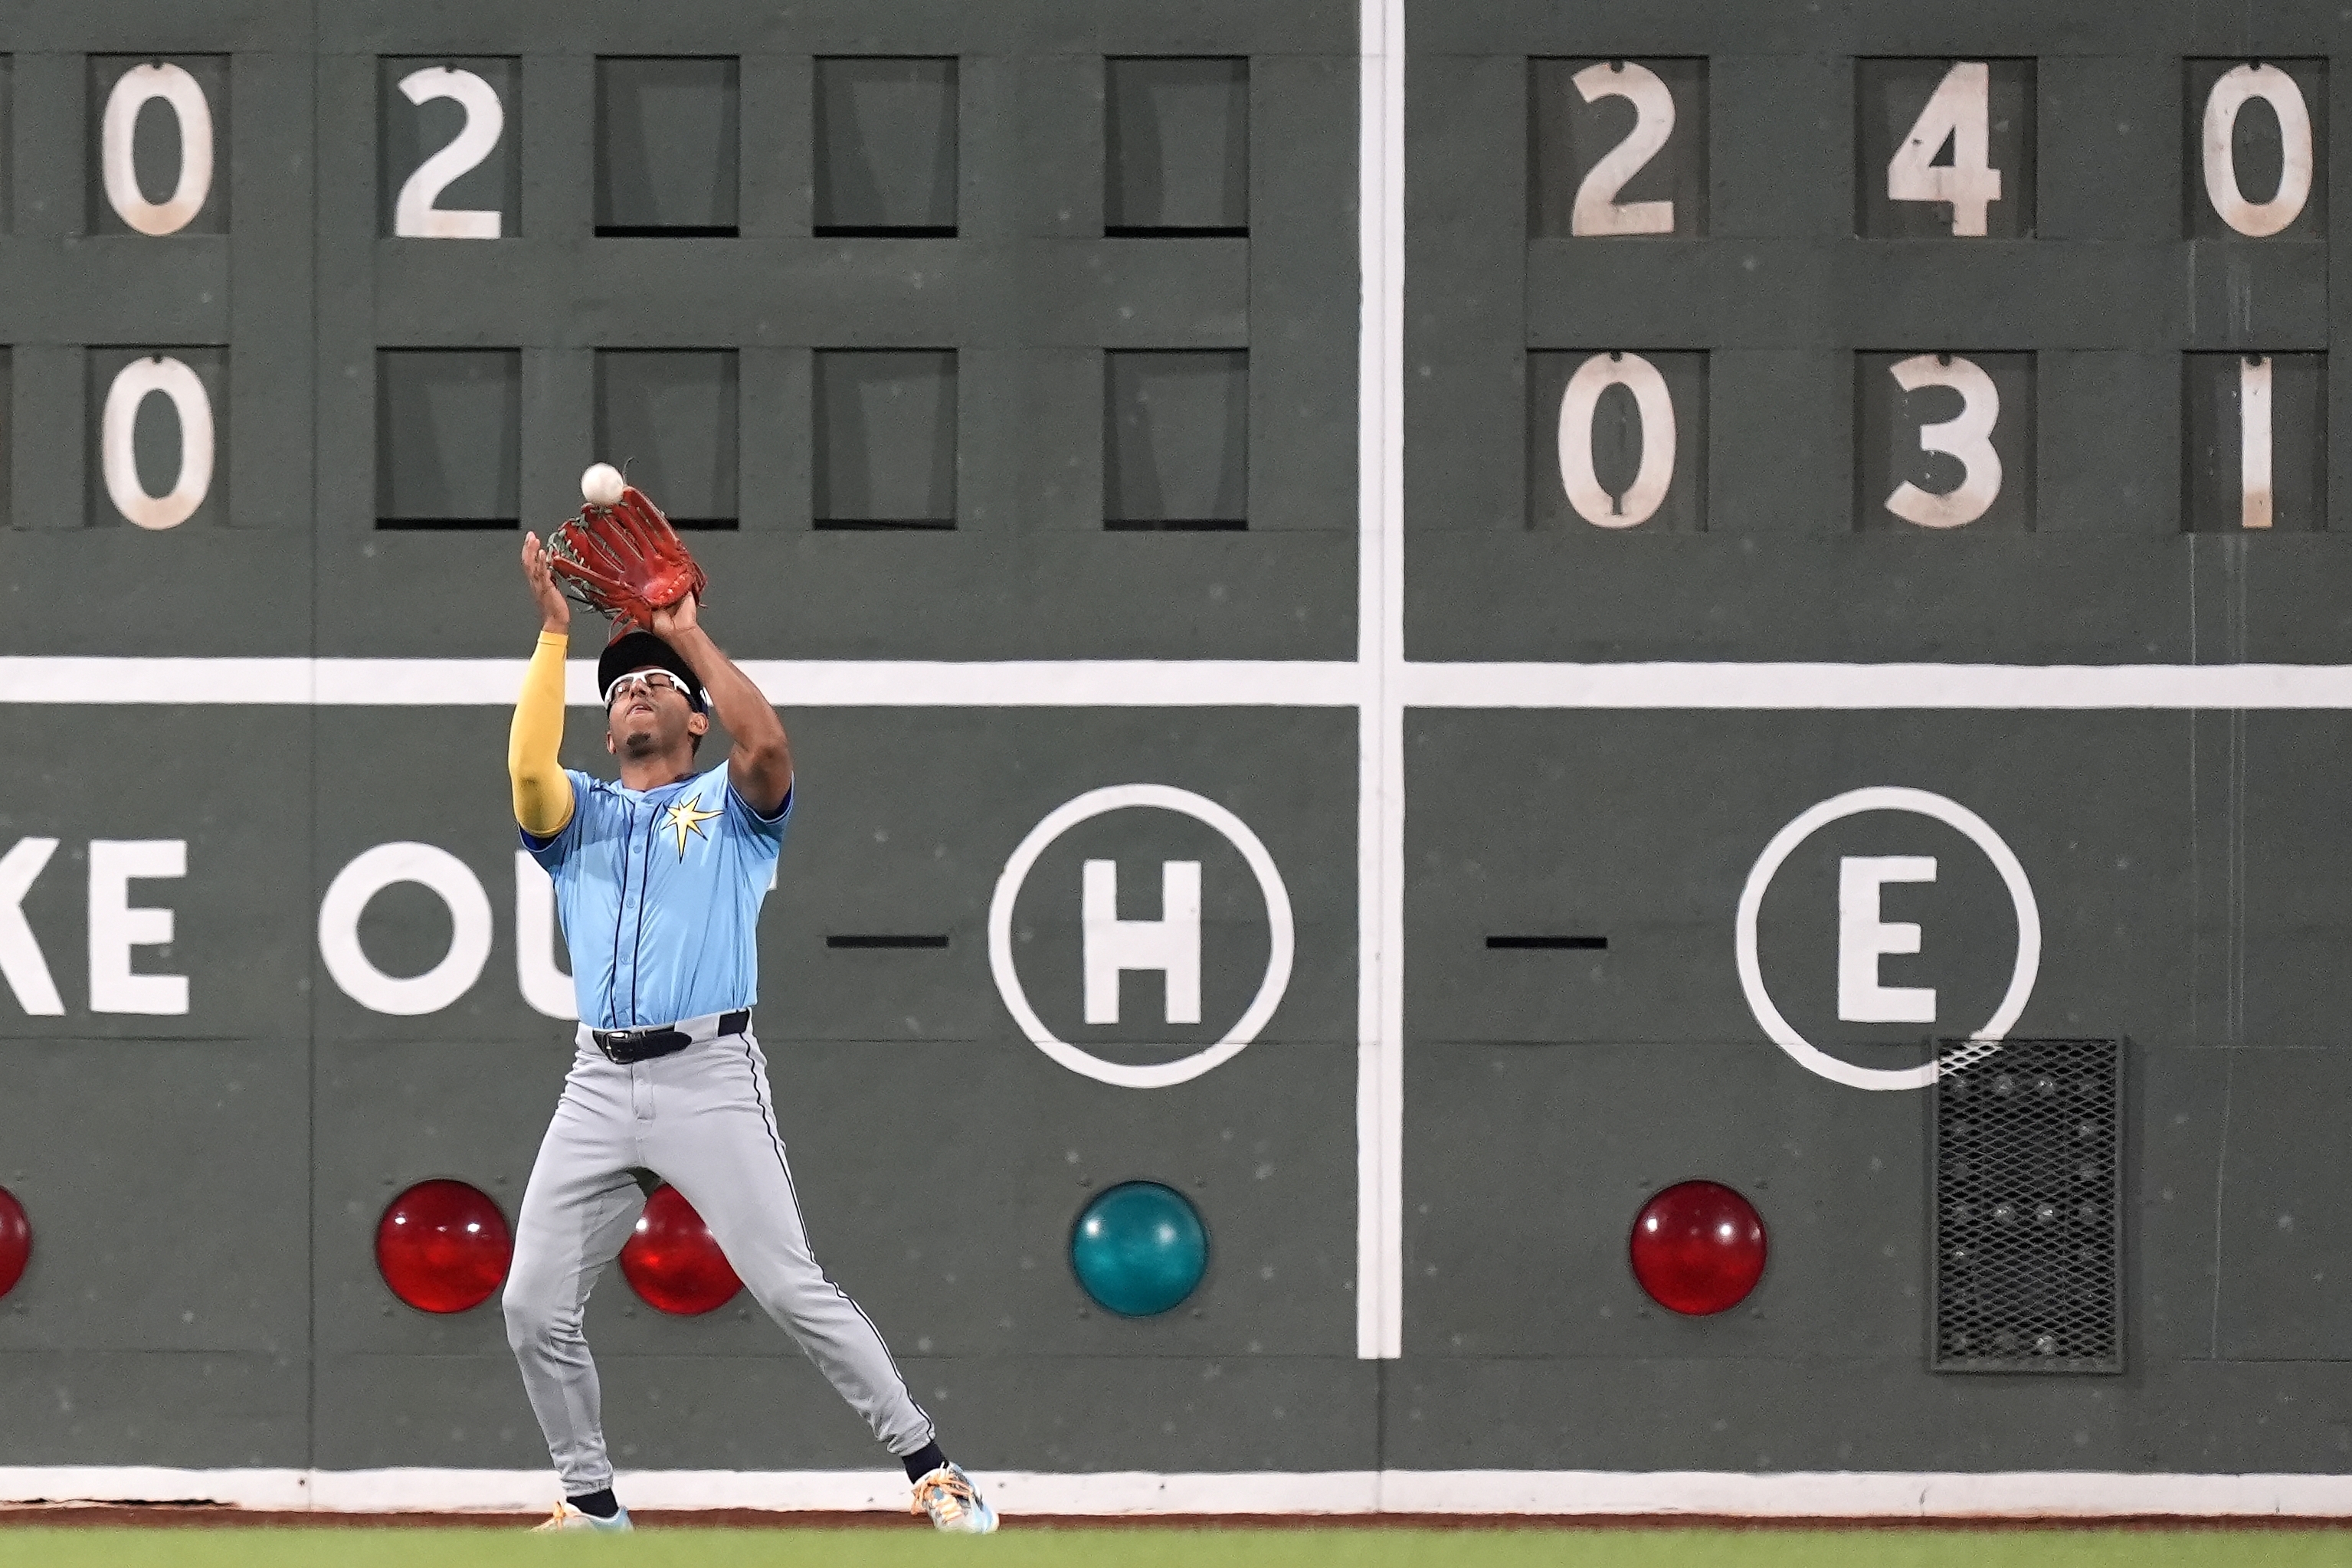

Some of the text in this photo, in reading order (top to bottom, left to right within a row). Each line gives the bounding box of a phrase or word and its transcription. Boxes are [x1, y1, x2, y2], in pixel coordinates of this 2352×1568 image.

[102, 64, 504, 239] 0 2
[1572, 62, 2312, 237] 2 4 0
[102, 357, 215, 529] 0
[1558, 352, 2272, 528] 0 3 1
[1082, 859, 1201, 1024] H
[1838, 856, 1937, 1023] E
